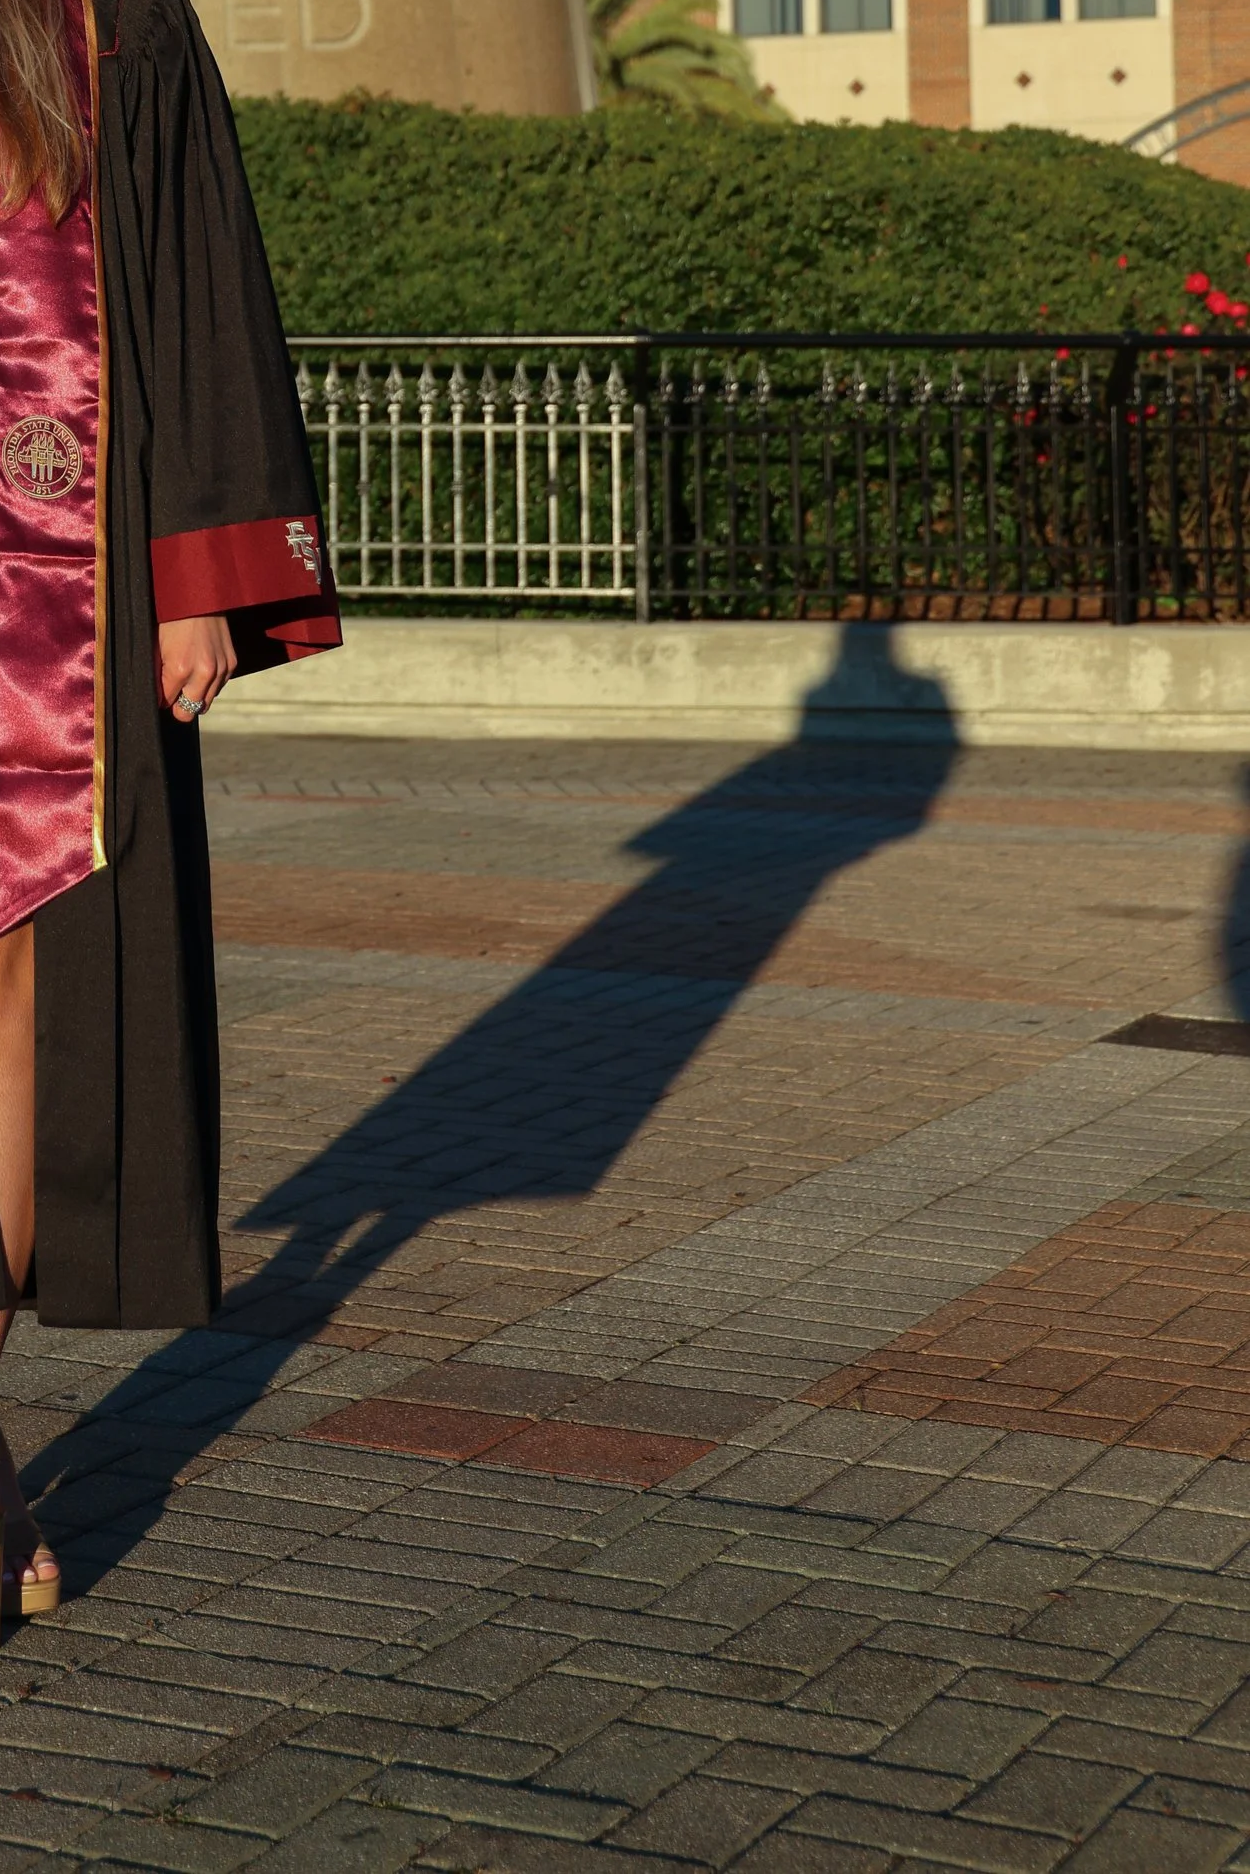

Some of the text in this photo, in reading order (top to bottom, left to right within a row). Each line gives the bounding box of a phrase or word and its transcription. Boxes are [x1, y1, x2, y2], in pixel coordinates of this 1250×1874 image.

[7, 421, 77, 483] FLORIDA STATE UNIVERSITY
[32, 485, 53, 495] 1851
